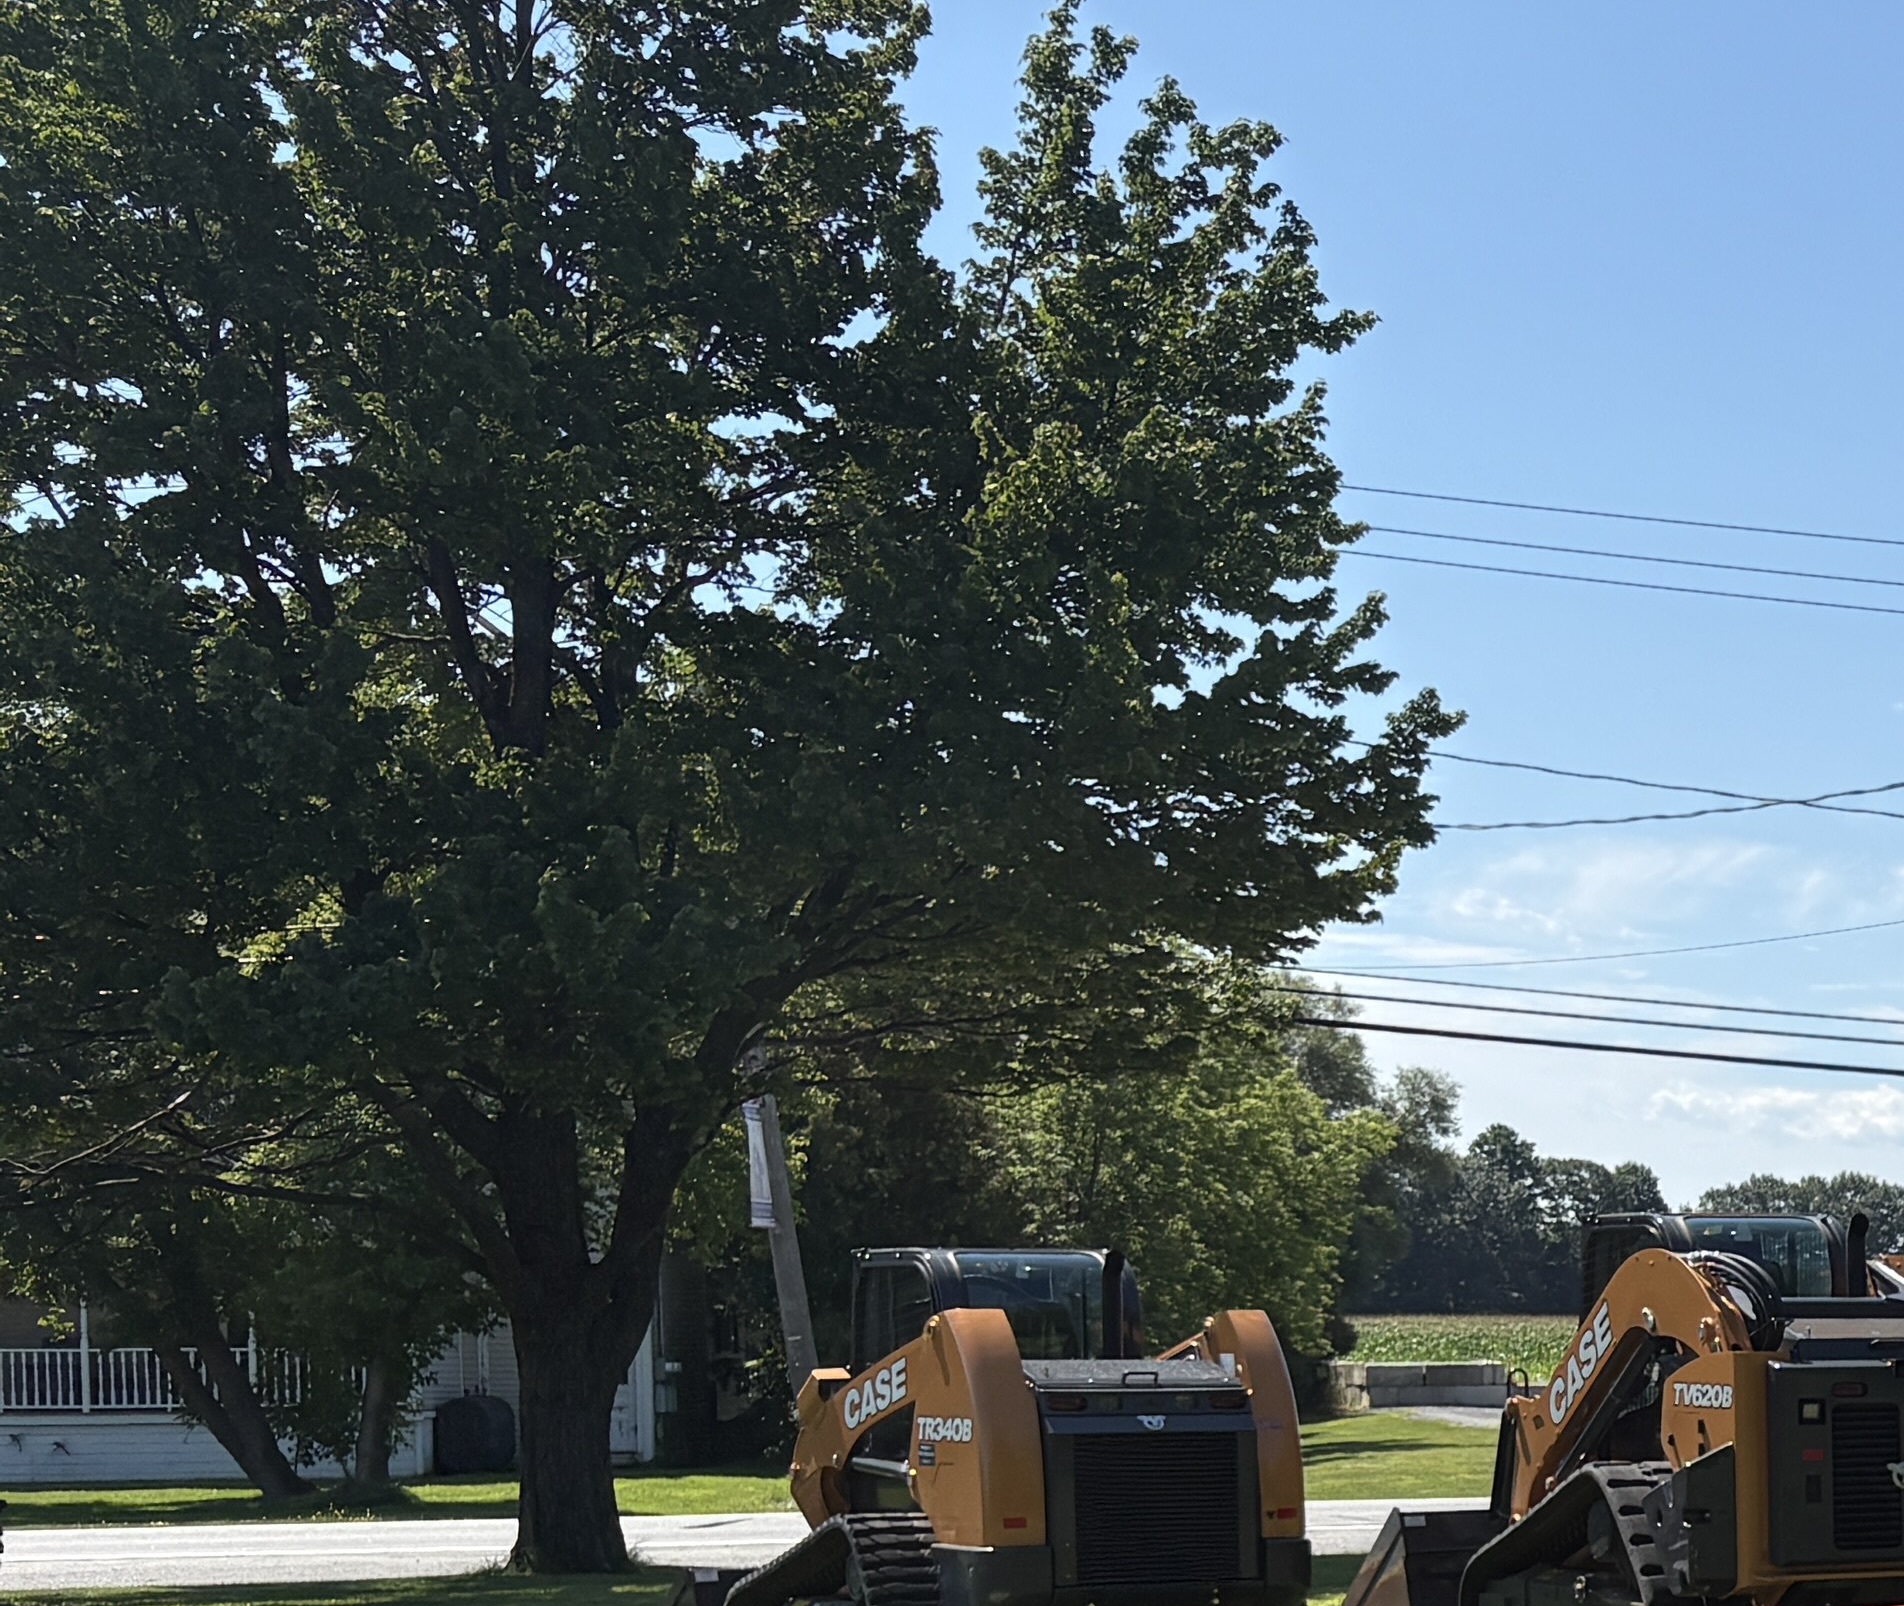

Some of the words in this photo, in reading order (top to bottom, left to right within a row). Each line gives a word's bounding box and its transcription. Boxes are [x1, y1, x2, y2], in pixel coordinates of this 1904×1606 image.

[1549, 1300, 1615, 1425] CASE
[844, 1356, 908, 1430] CASE
[1673, 1383, 1733, 1409] TV620B
[917, 1416, 974, 1443] TR340B
